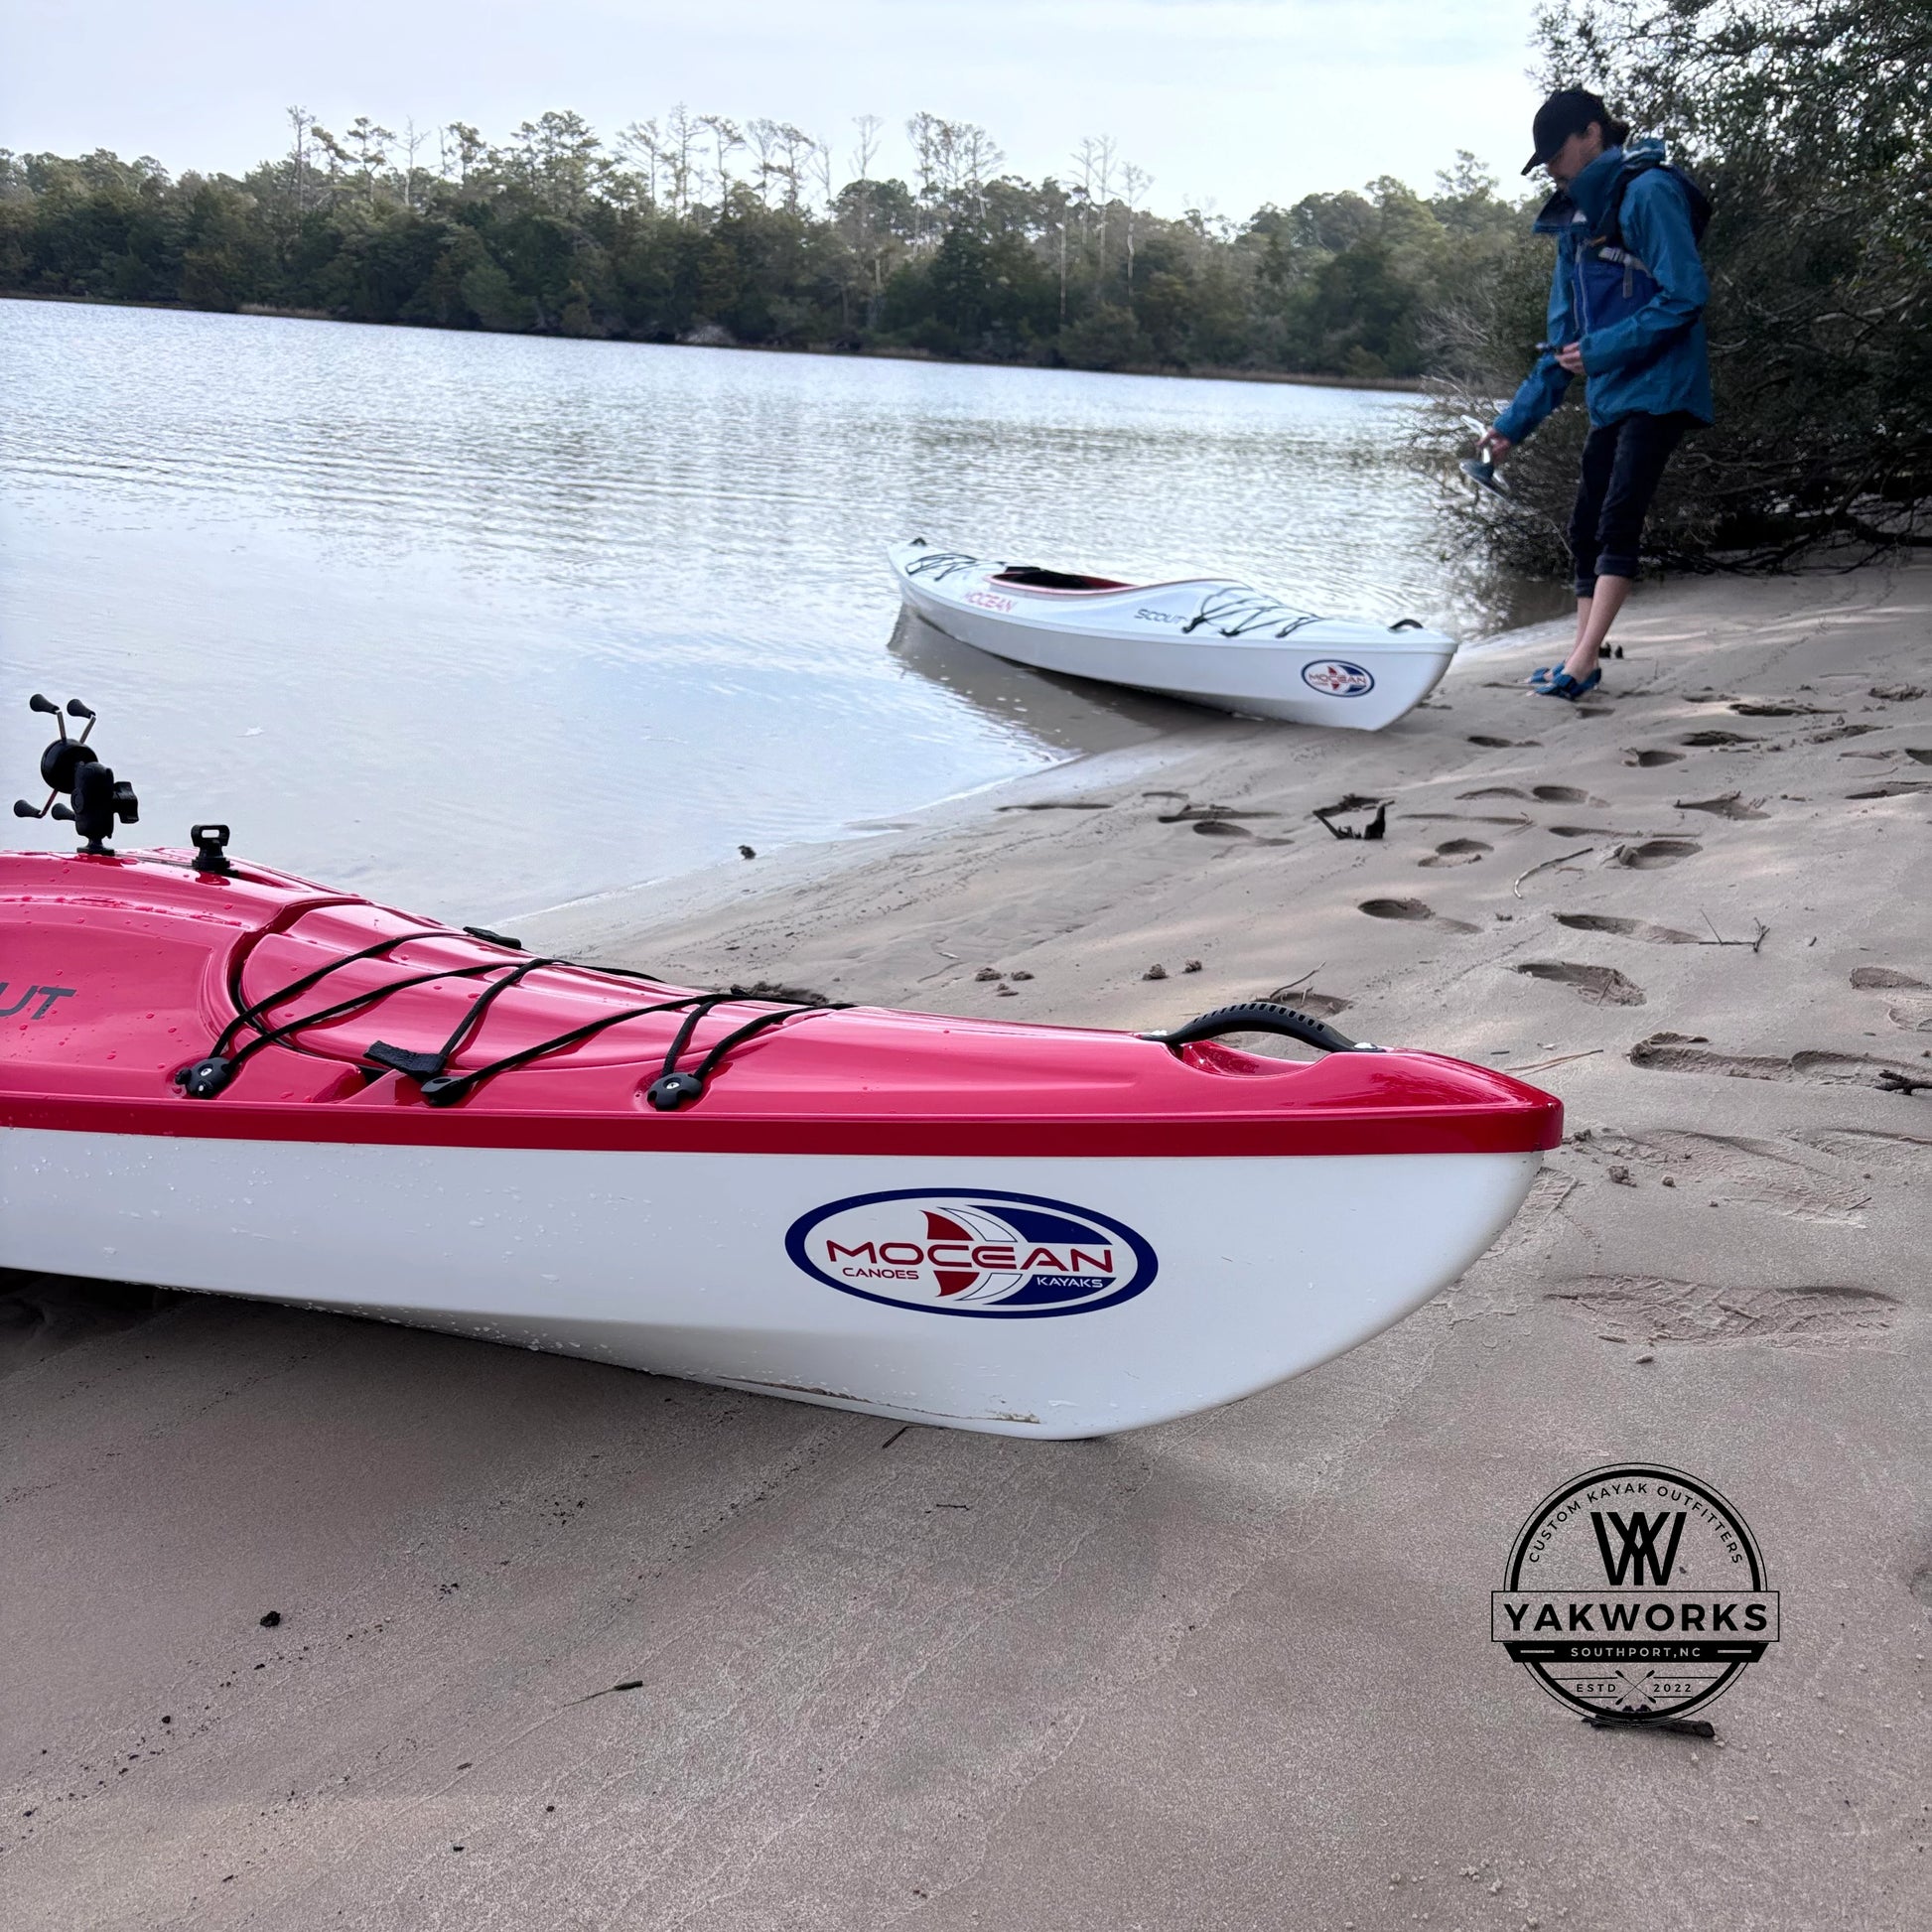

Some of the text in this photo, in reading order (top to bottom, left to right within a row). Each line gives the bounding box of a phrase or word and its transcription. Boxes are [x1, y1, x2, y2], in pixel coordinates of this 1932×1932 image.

[1308, 673, 1366, 683] MOCEAN
[826, 1239, 1113, 1273] MOCEAN
[842, 1267, 919, 1280] CANOES
[1036, 1277, 1103, 1288] KAYAKS
